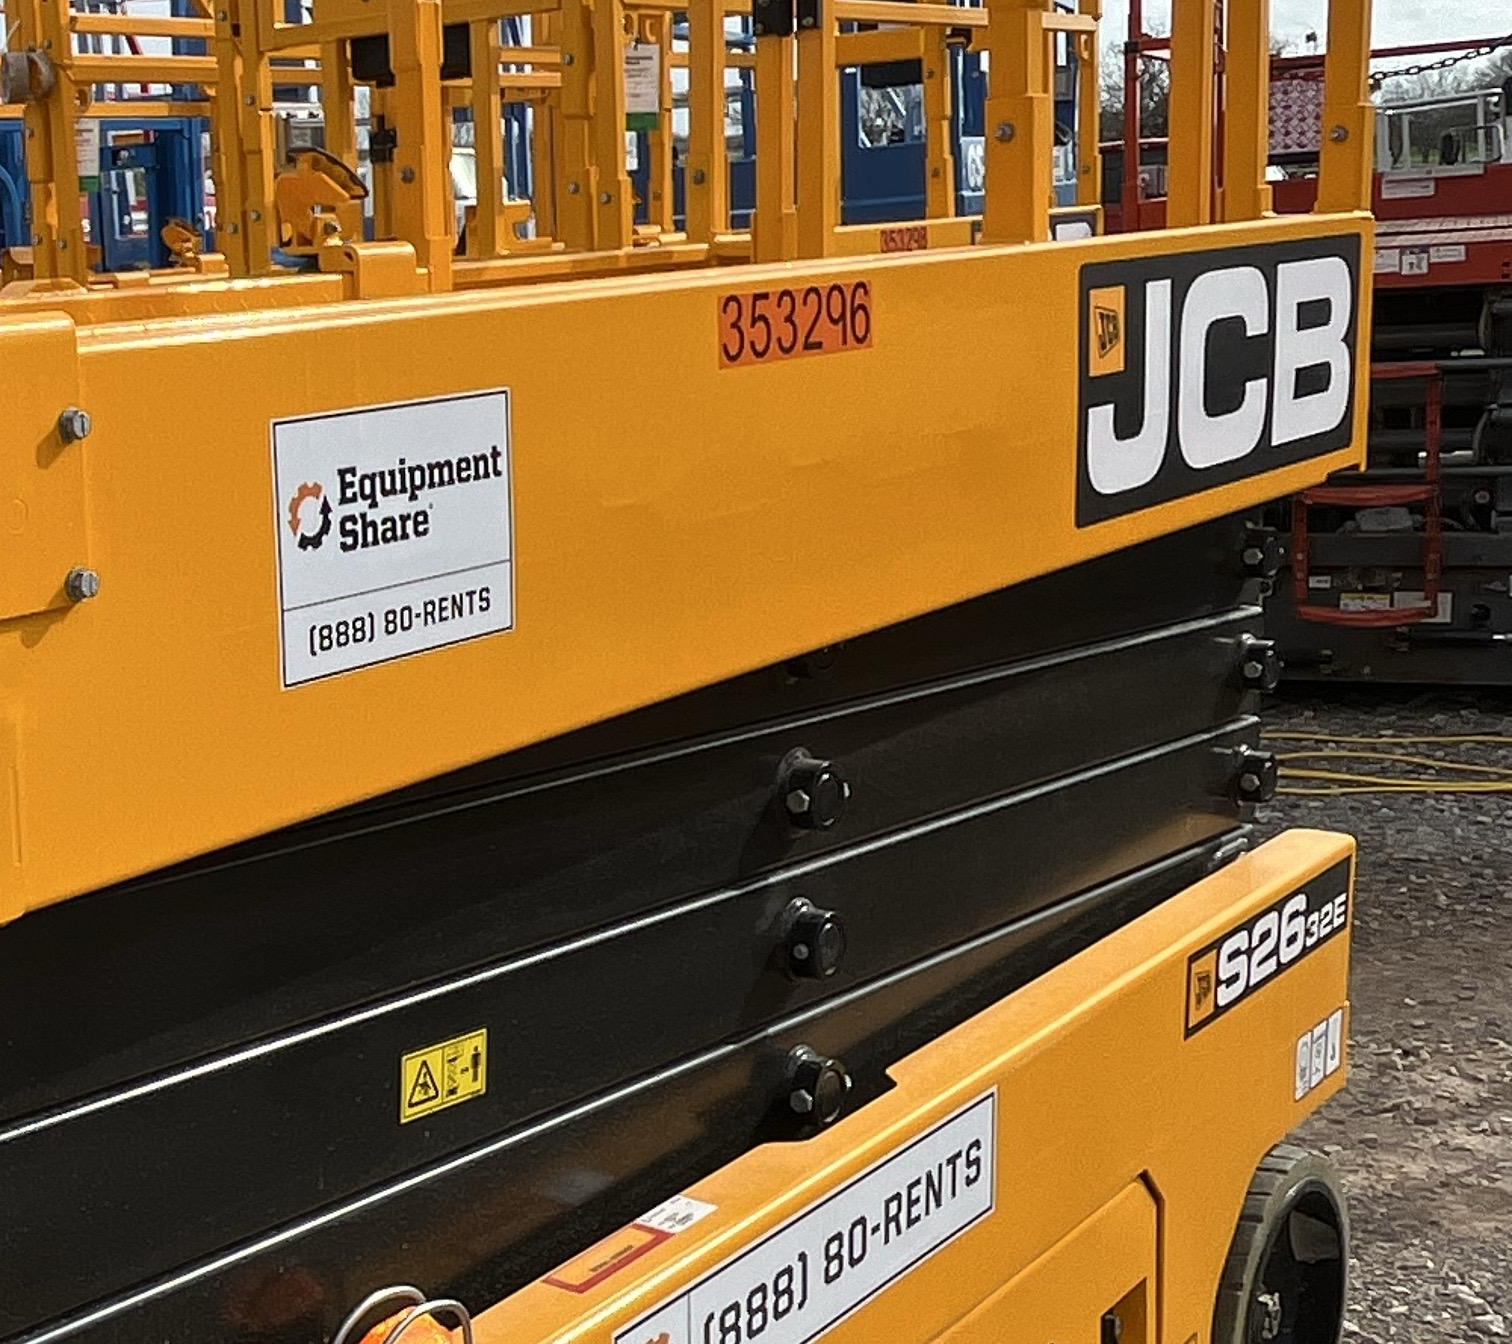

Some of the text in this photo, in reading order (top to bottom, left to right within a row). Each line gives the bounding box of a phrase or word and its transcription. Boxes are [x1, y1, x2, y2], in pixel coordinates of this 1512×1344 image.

[722, 281, 871, 362] 353296
[1088, 256, 1352, 495] JCB
[337, 445, 502, 508] Equipment
[339, 508, 430, 553] Share
[309, 587, 491, 656] (888) 80-RENTS
[824, 1138, 982, 1284] 80-RENTS
